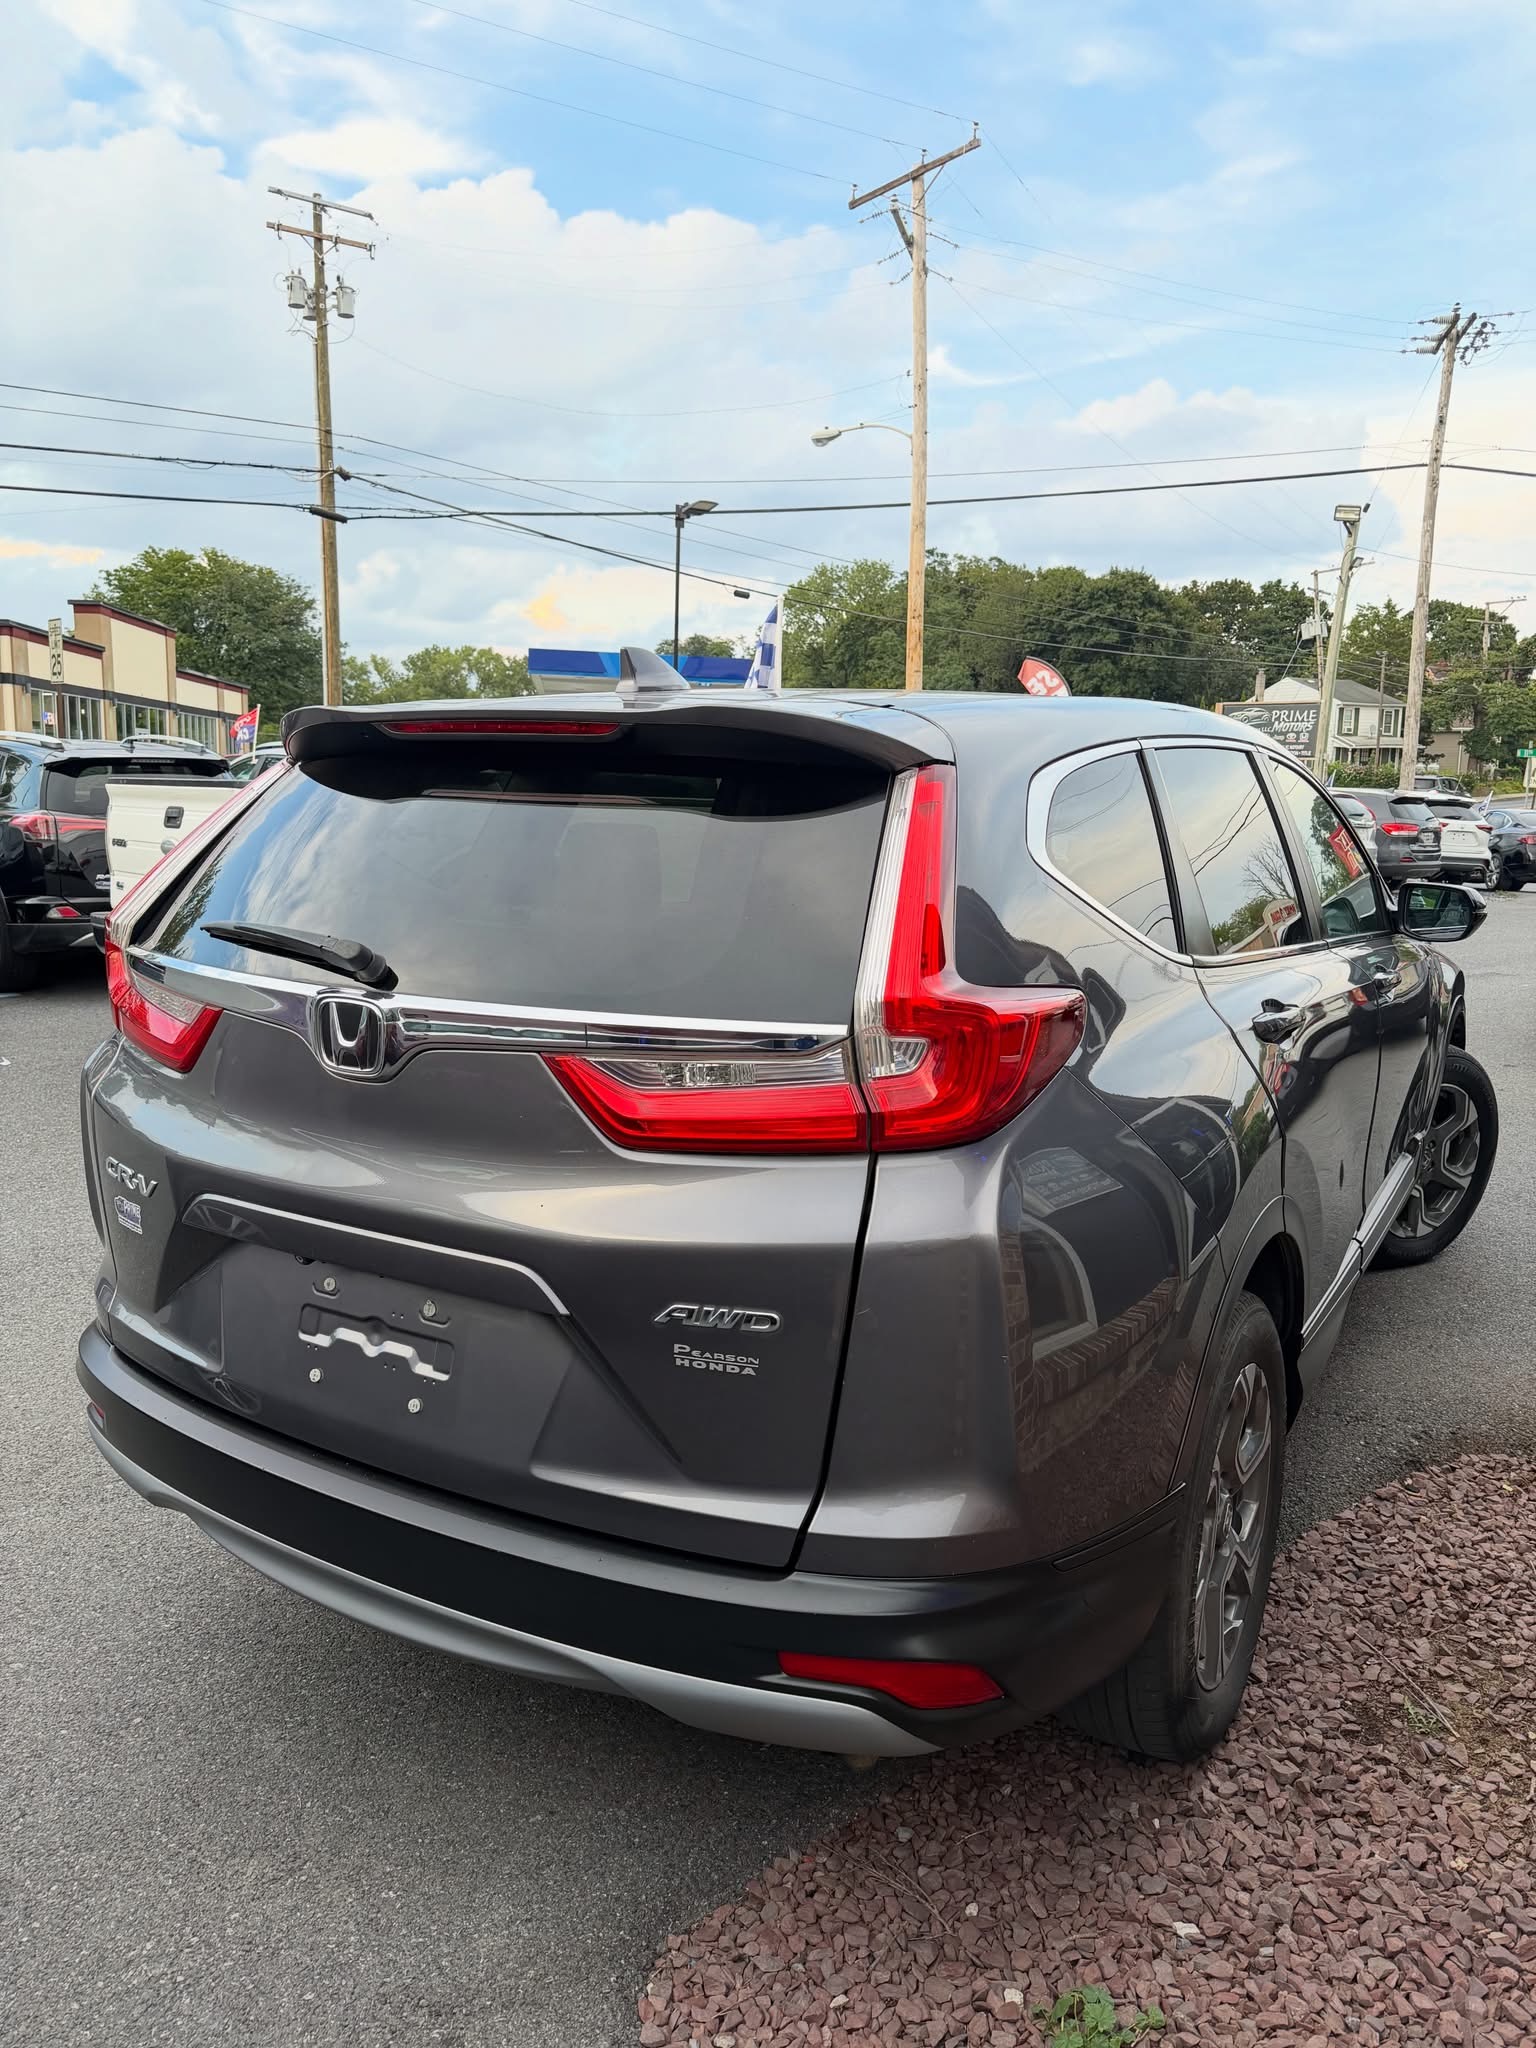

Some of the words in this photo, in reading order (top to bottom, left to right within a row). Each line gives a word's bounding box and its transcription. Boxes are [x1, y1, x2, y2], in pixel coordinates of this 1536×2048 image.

[51, 653, 62, 677] 25
[1271, 709, 1318, 722] PRIME
[1271, 721, 1315, 733] MOTORS
[105, 1156, 159, 1198] CR-V
[653, 1303, 783, 1333] AWD
[675, 1357, 757, 1376] HONDA
